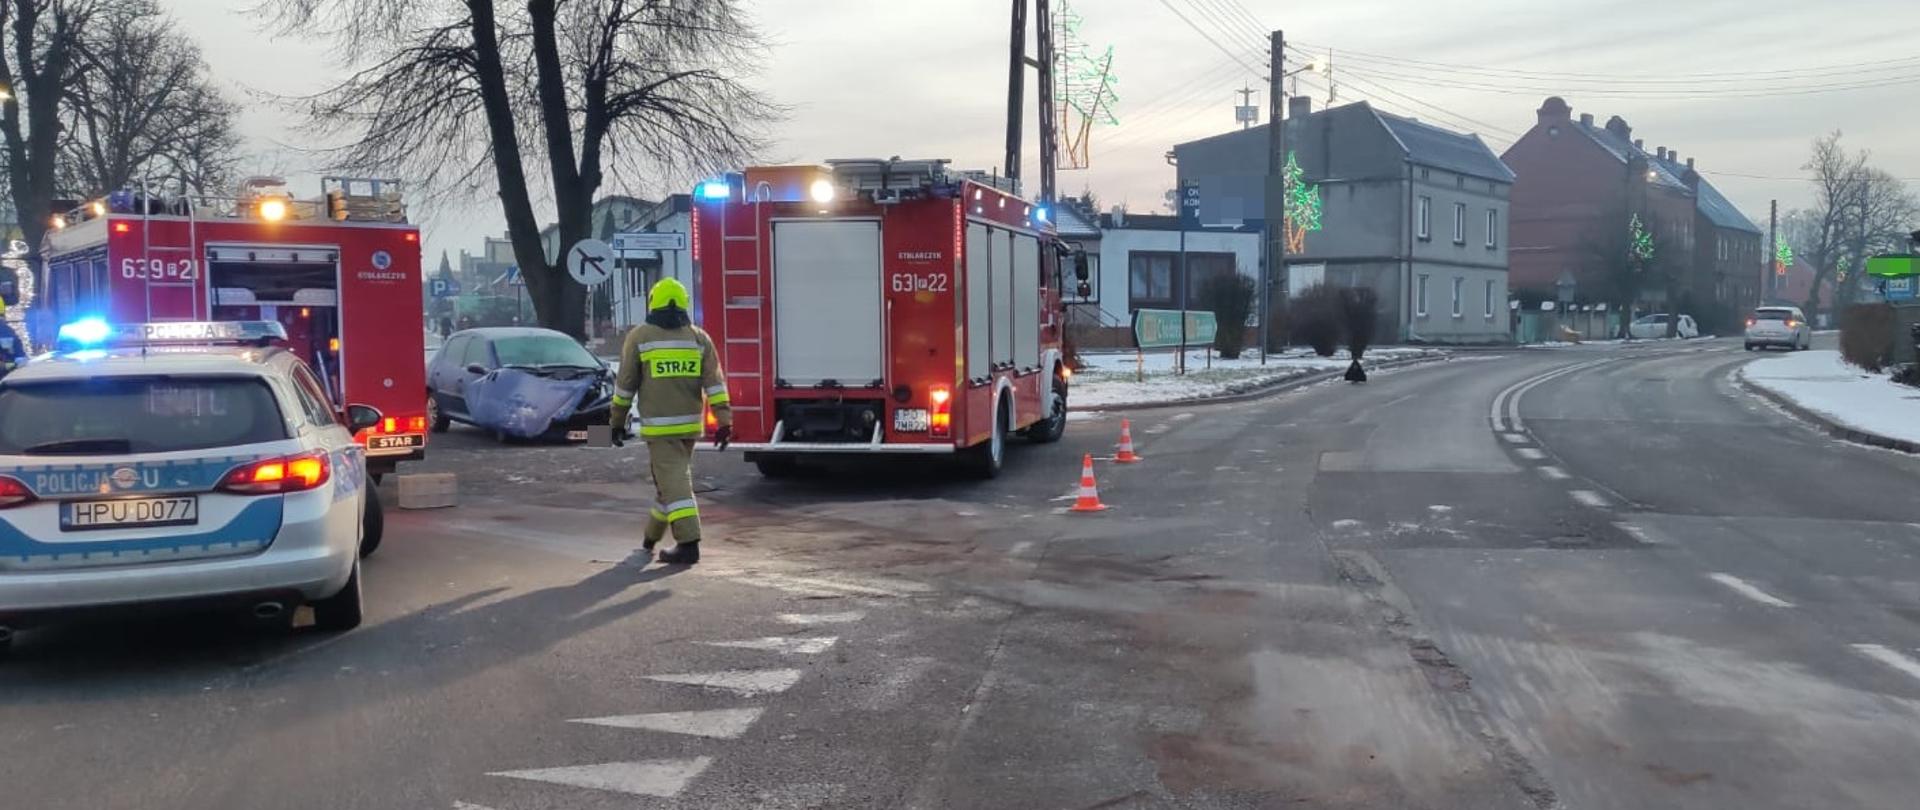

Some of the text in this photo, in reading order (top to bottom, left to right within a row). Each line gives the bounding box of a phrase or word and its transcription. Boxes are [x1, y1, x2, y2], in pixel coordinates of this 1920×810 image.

[434, 280, 446, 296] P
[380, 437, 412, 447] STAR
[36, 471, 111, 494] POLICJA
[76, 499, 193, 524] HPU D077
